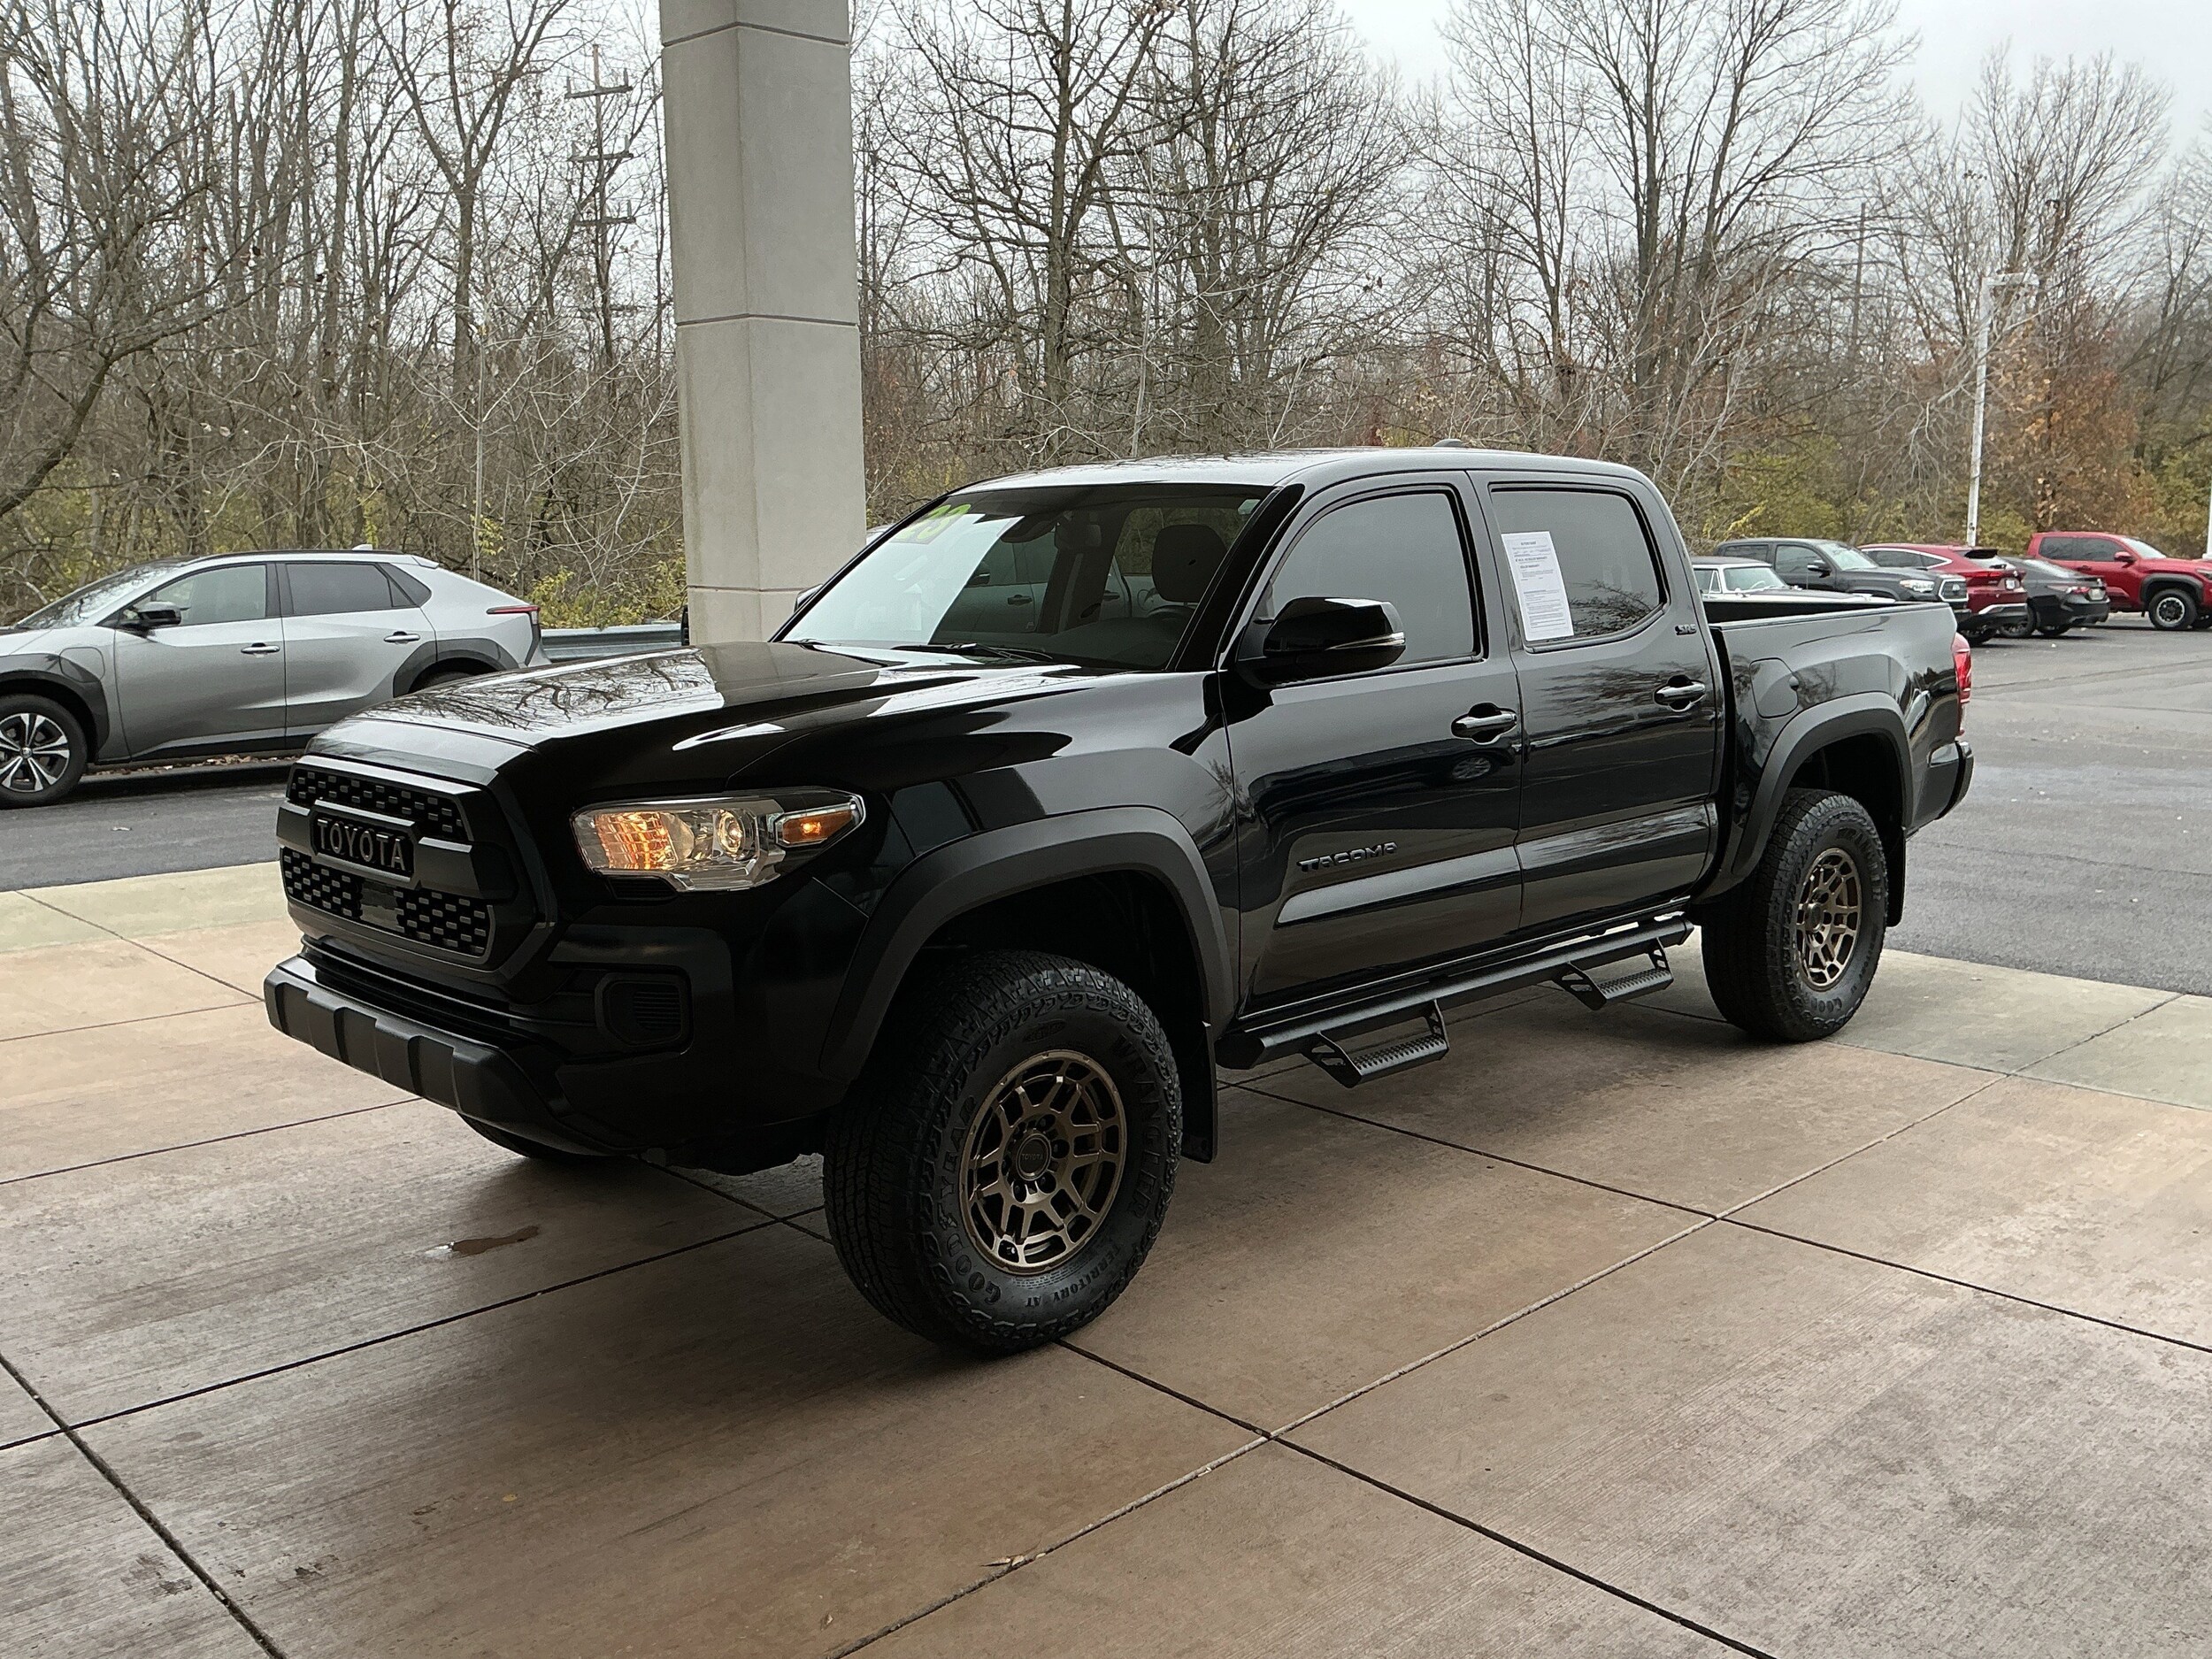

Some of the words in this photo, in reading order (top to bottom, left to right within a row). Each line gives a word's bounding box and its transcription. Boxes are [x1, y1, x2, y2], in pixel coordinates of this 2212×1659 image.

[317, 818, 406, 872] TOYOTA
[1296, 841, 1398, 872] TACOMA
[1110, 1033, 1162, 1218] WRANGLER
[937, 1094, 1002, 1305] GOODYEAR
[1053, 1243, 1121, 1302] TERRITORY
